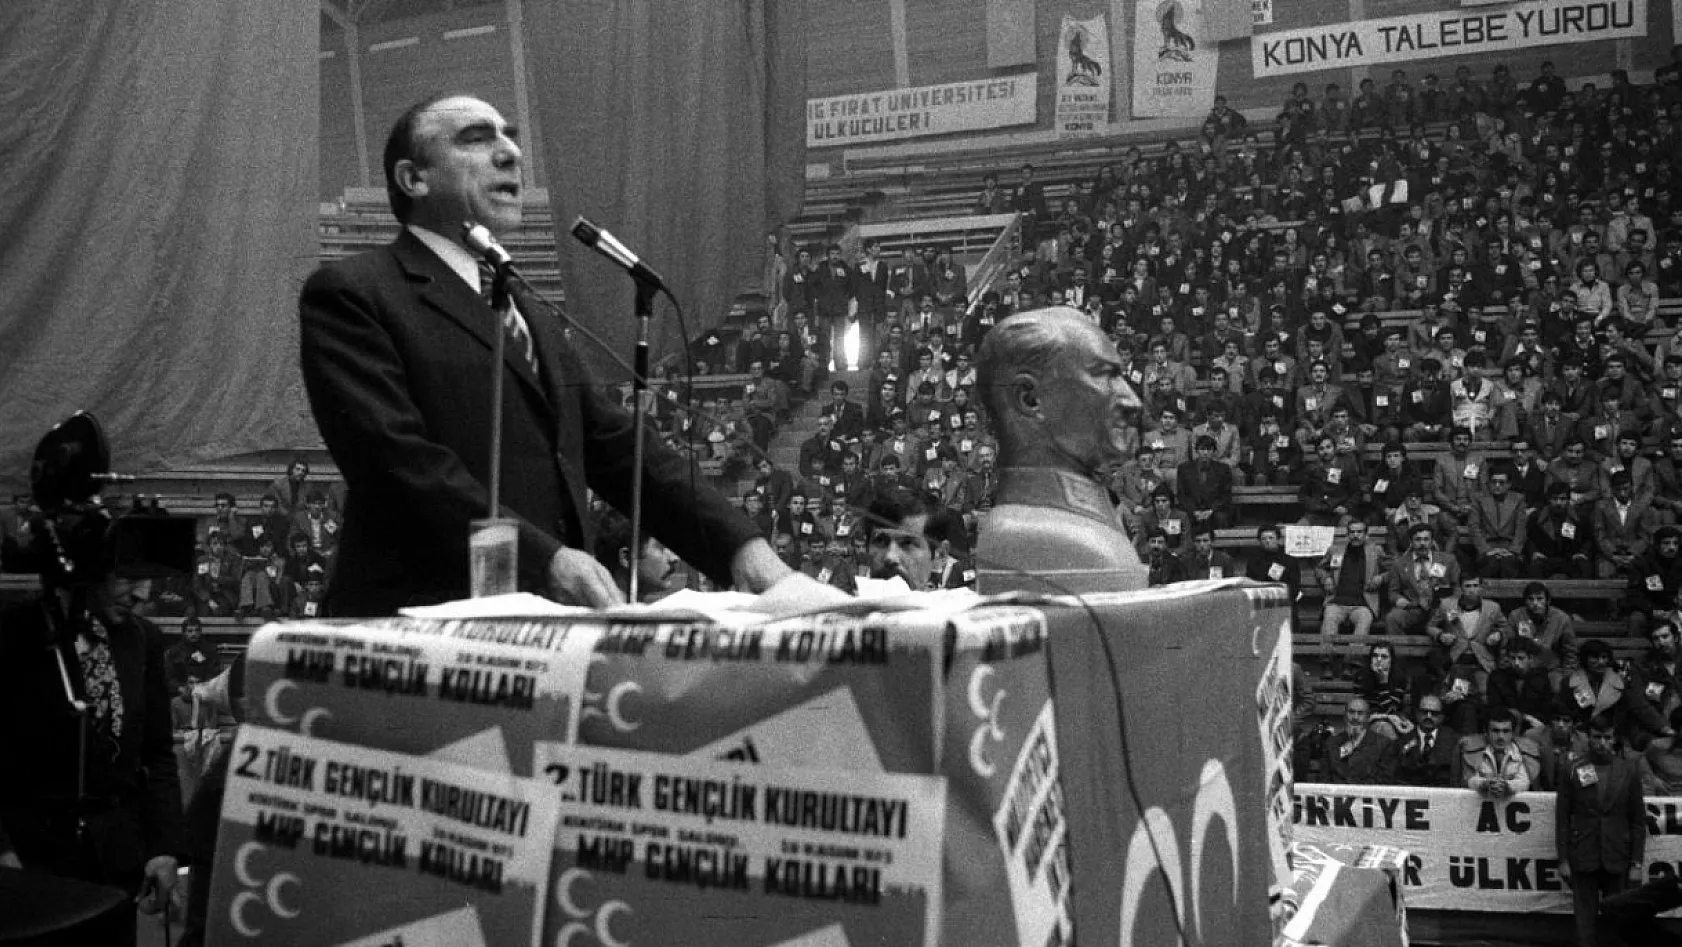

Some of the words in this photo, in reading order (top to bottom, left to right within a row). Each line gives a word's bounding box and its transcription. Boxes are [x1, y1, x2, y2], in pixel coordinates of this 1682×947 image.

[1263, 31, 1363, 67] KONYA
[1377, 14, 1509, 53] TALEBE
[1516, 1, 1634, 37] YURDU
[440, 667, 536, 710] KOLLARI
[264, 746, 317, 791] TÜRK
[324, 760, 415, 808] GENÇLİK
[420, 779, 529, 838] KURULTAYI
[579, 762, 641, 810] TÜRK
[654, 774, 756, 824] GENÇLİK
[764, 786, 909, 839] KURULTAYI
[1293, 795, 1430, 830] RKİYE
[257, 811, 304, 848] MHP
[419, 840, 503, 896] KOLLARI
[576, 833, 634, 874] MHP
[764, 856, 880, 905] KOLLARI
